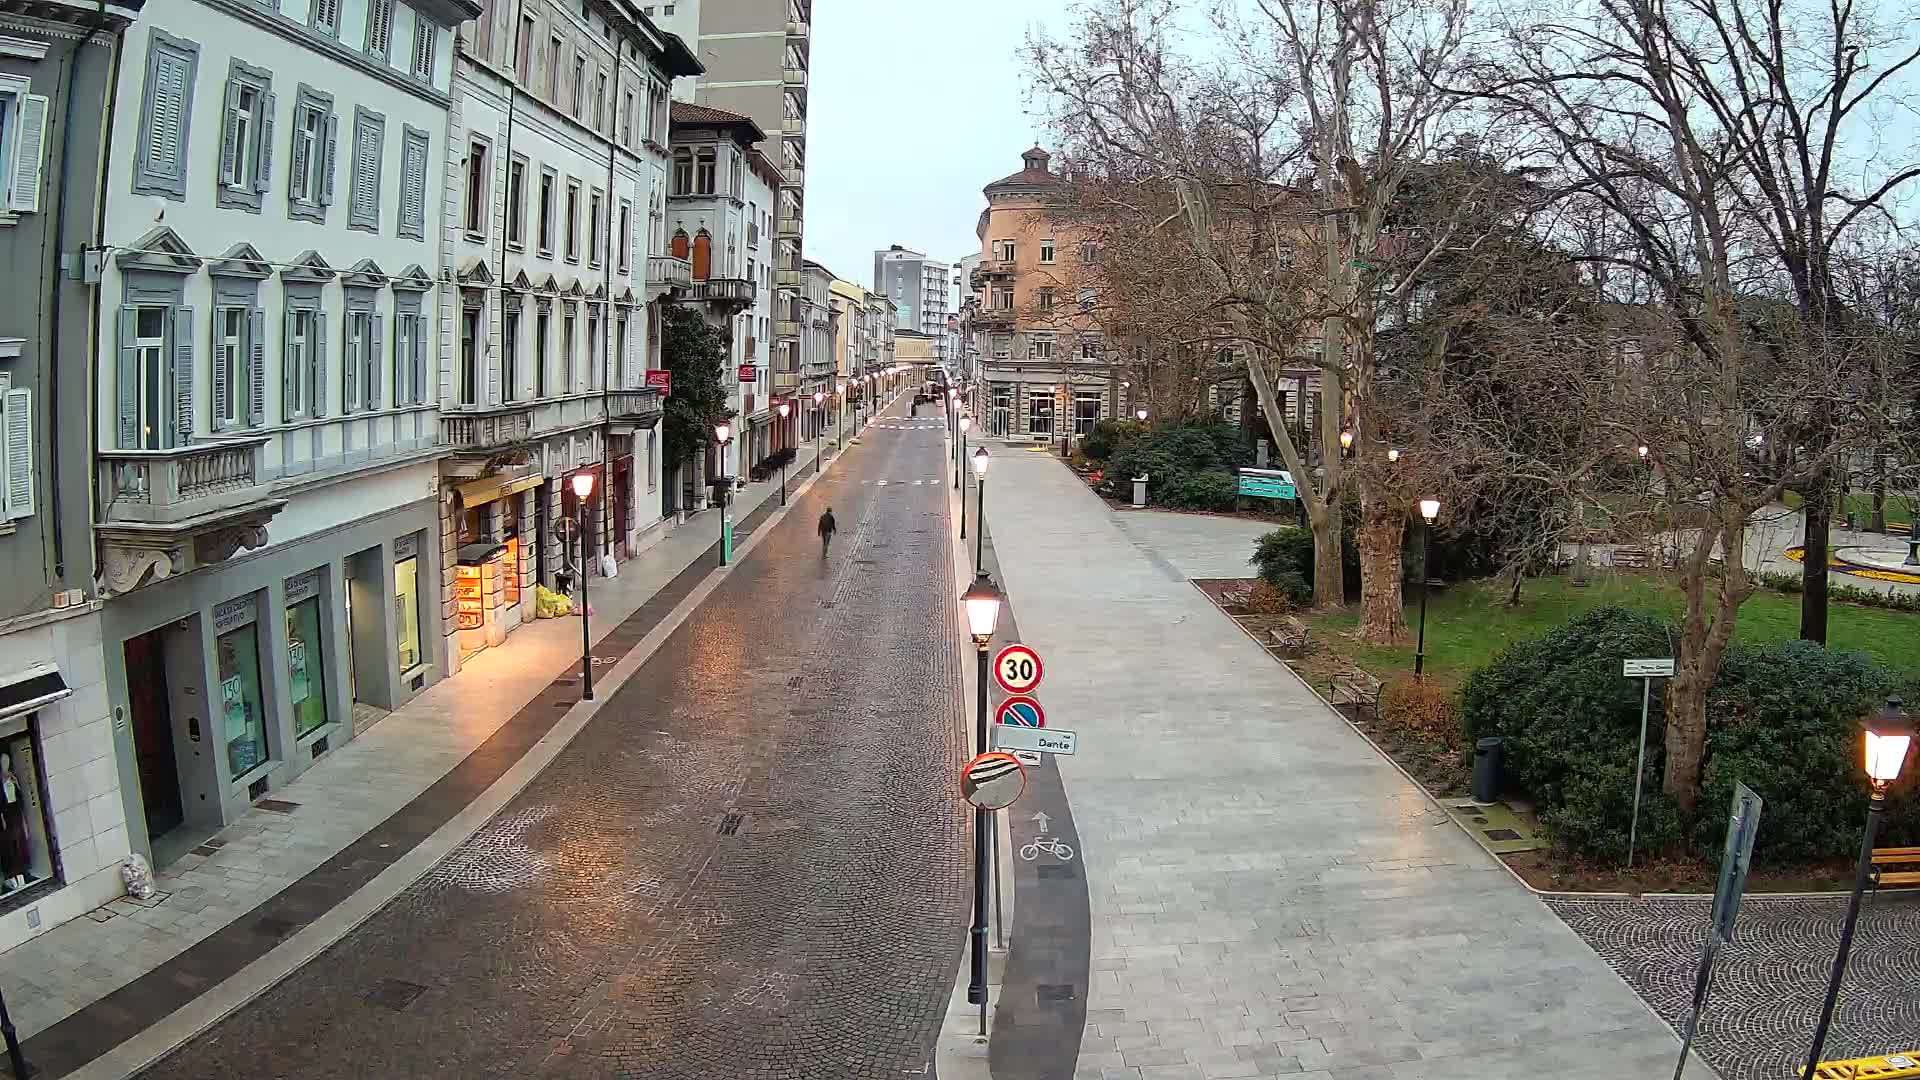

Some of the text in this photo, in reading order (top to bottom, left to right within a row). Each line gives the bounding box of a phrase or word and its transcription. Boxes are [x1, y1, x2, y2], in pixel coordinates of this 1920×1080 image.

[1005, 659, 1033, 681] 30
[223, 678, 240, 700] 130
[1038, 738, 1070, 750] Dante
